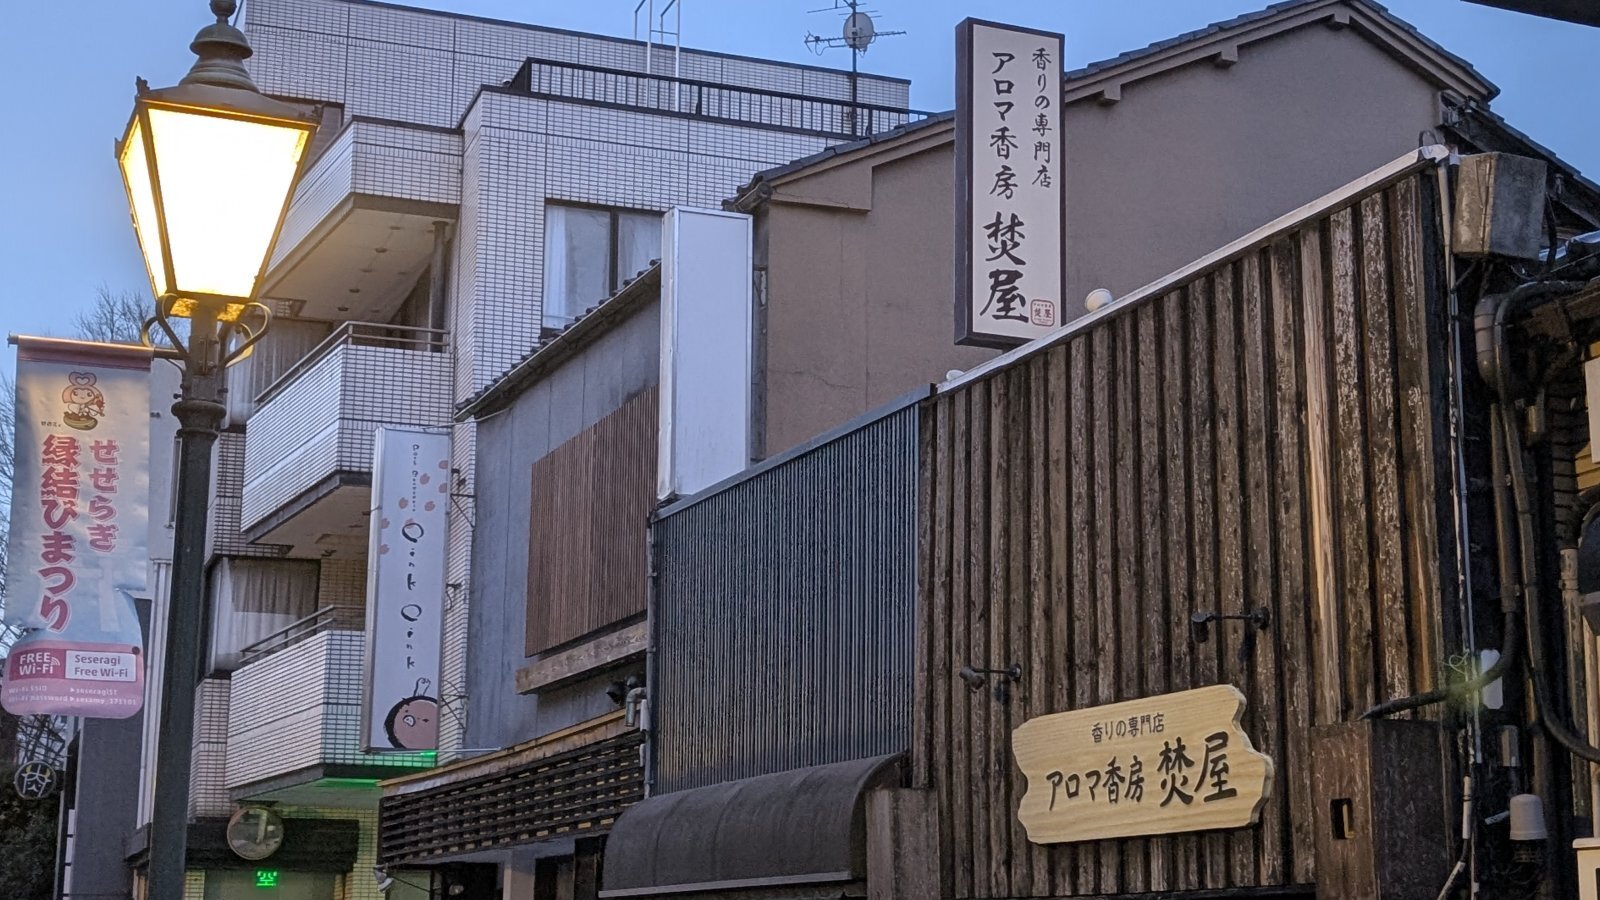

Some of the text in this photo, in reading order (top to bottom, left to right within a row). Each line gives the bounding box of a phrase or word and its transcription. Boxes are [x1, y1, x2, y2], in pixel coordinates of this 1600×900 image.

[1032, 47, 1053, 189] 香りの専門店
[979, 51, 1029, 324] アロマ香房 焚屋
[87, 439, 119, 552] せせらぎ
[38, 434, 80, 632] 縁結びまつり
[400, 522, 424, 670] Oink Oink
[19, 663, 54, 676] Wi-Fi
[20, 652, 51, 665] FREE
[74, 654, 121, 667] Seseragi
[74, 667, 129, 678] Free Wi-Fi
[1091, 711, 1165, 744] 香りの専門店
[1046, 730, 1238, 812] アロマ香房 焚屋
[256, 871, 278, 887] 空
